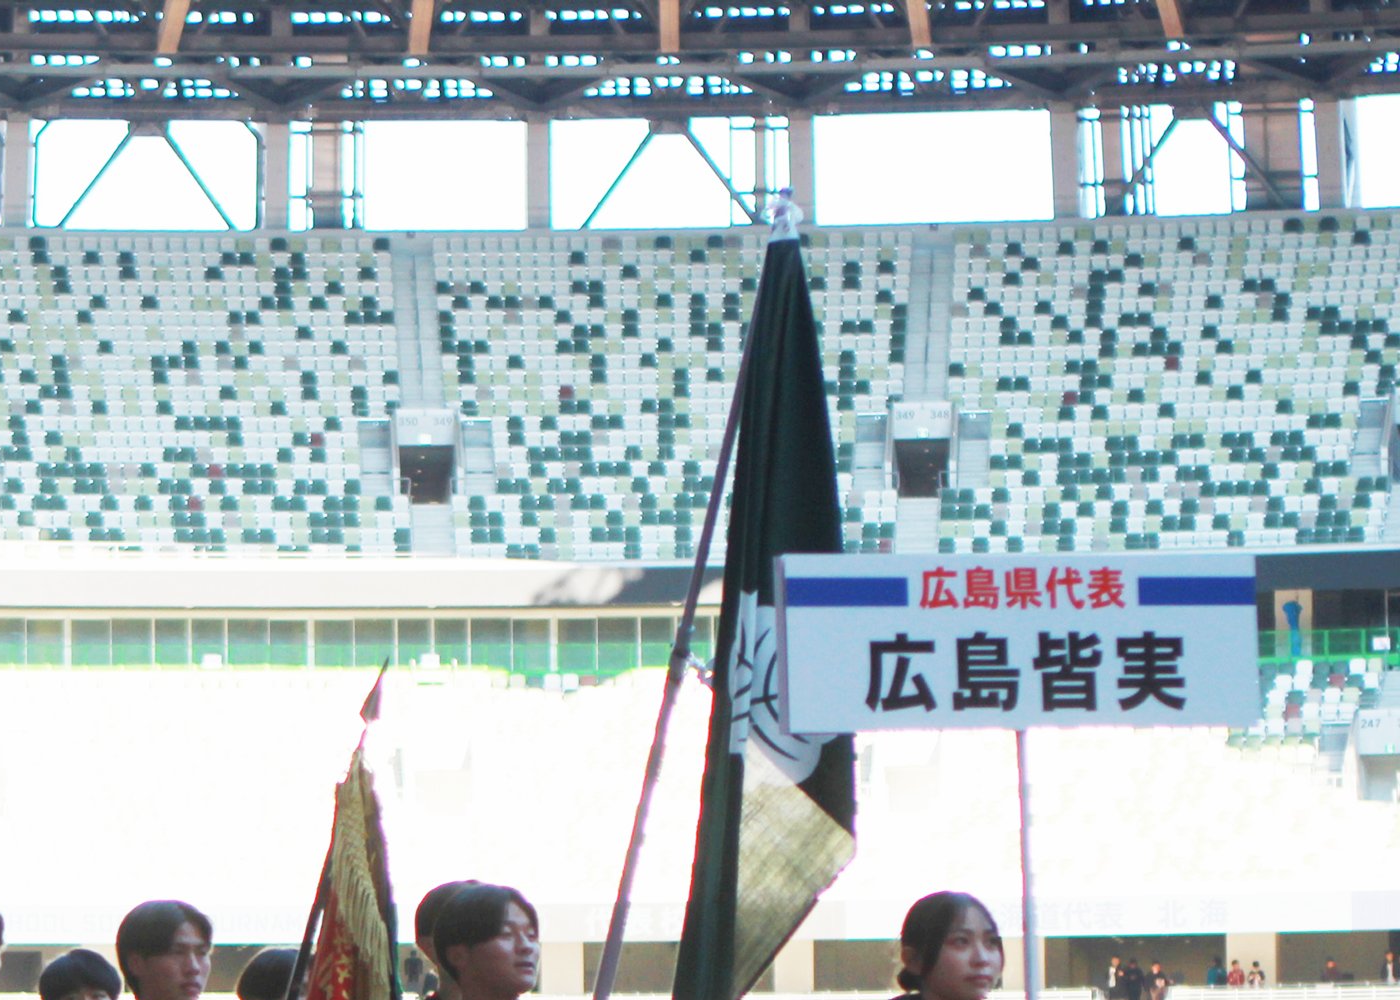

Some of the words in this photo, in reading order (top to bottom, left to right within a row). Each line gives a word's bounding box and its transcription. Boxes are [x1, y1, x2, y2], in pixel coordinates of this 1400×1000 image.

[919, 565, 1127, 610] 広島県代表
[864, 630, 1187, 713] 広島皆実
[1360, 718, 1382, 729] 247
